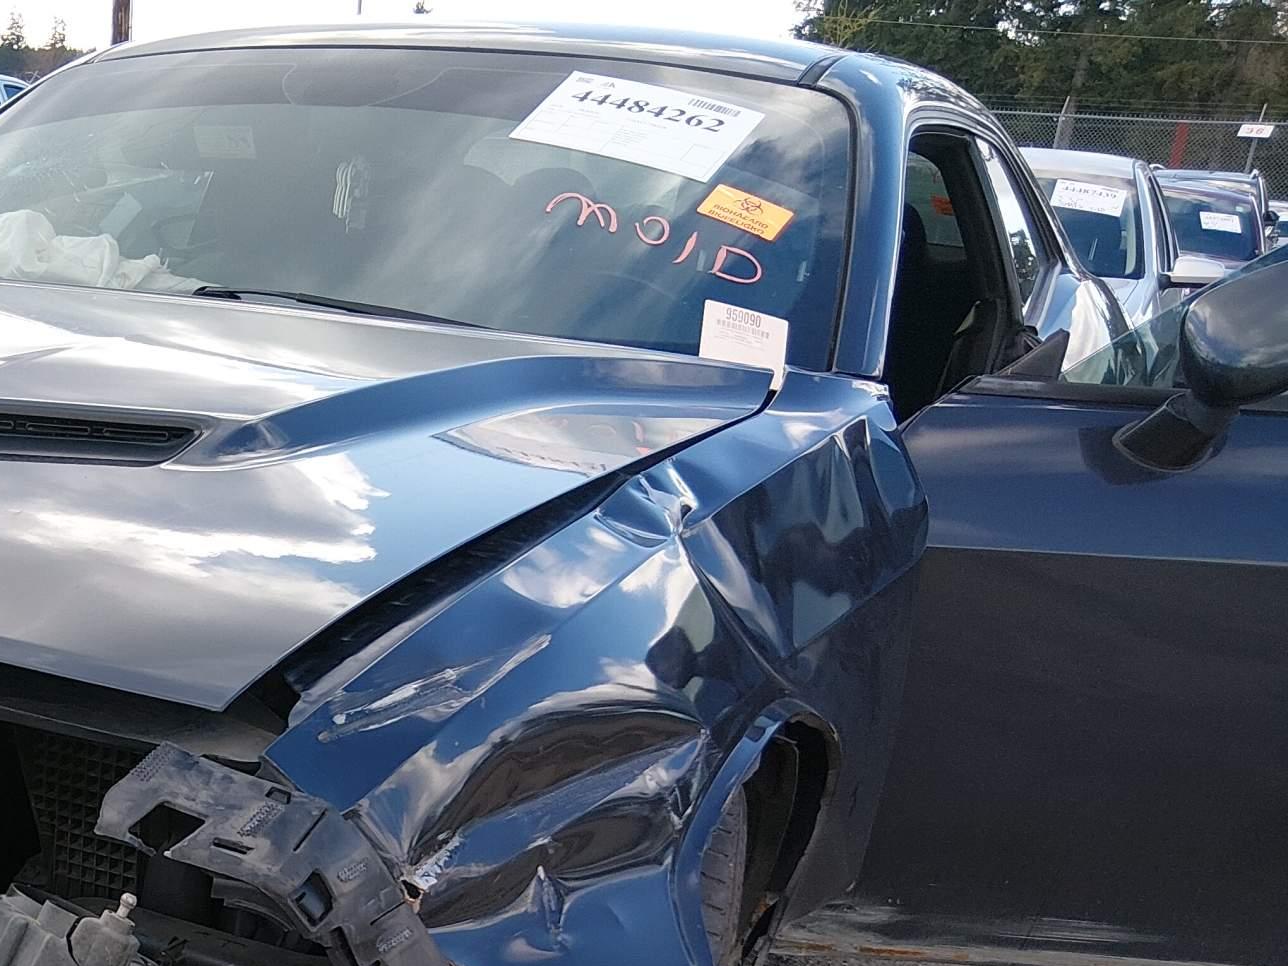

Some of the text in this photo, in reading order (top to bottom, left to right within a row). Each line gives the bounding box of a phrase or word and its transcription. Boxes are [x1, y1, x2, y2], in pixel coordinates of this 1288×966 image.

[570, 90, 726, 133] 44484262
[713, 203, 769, 230] BIOHAZARD
[725, 307, 762, 329] 959090
